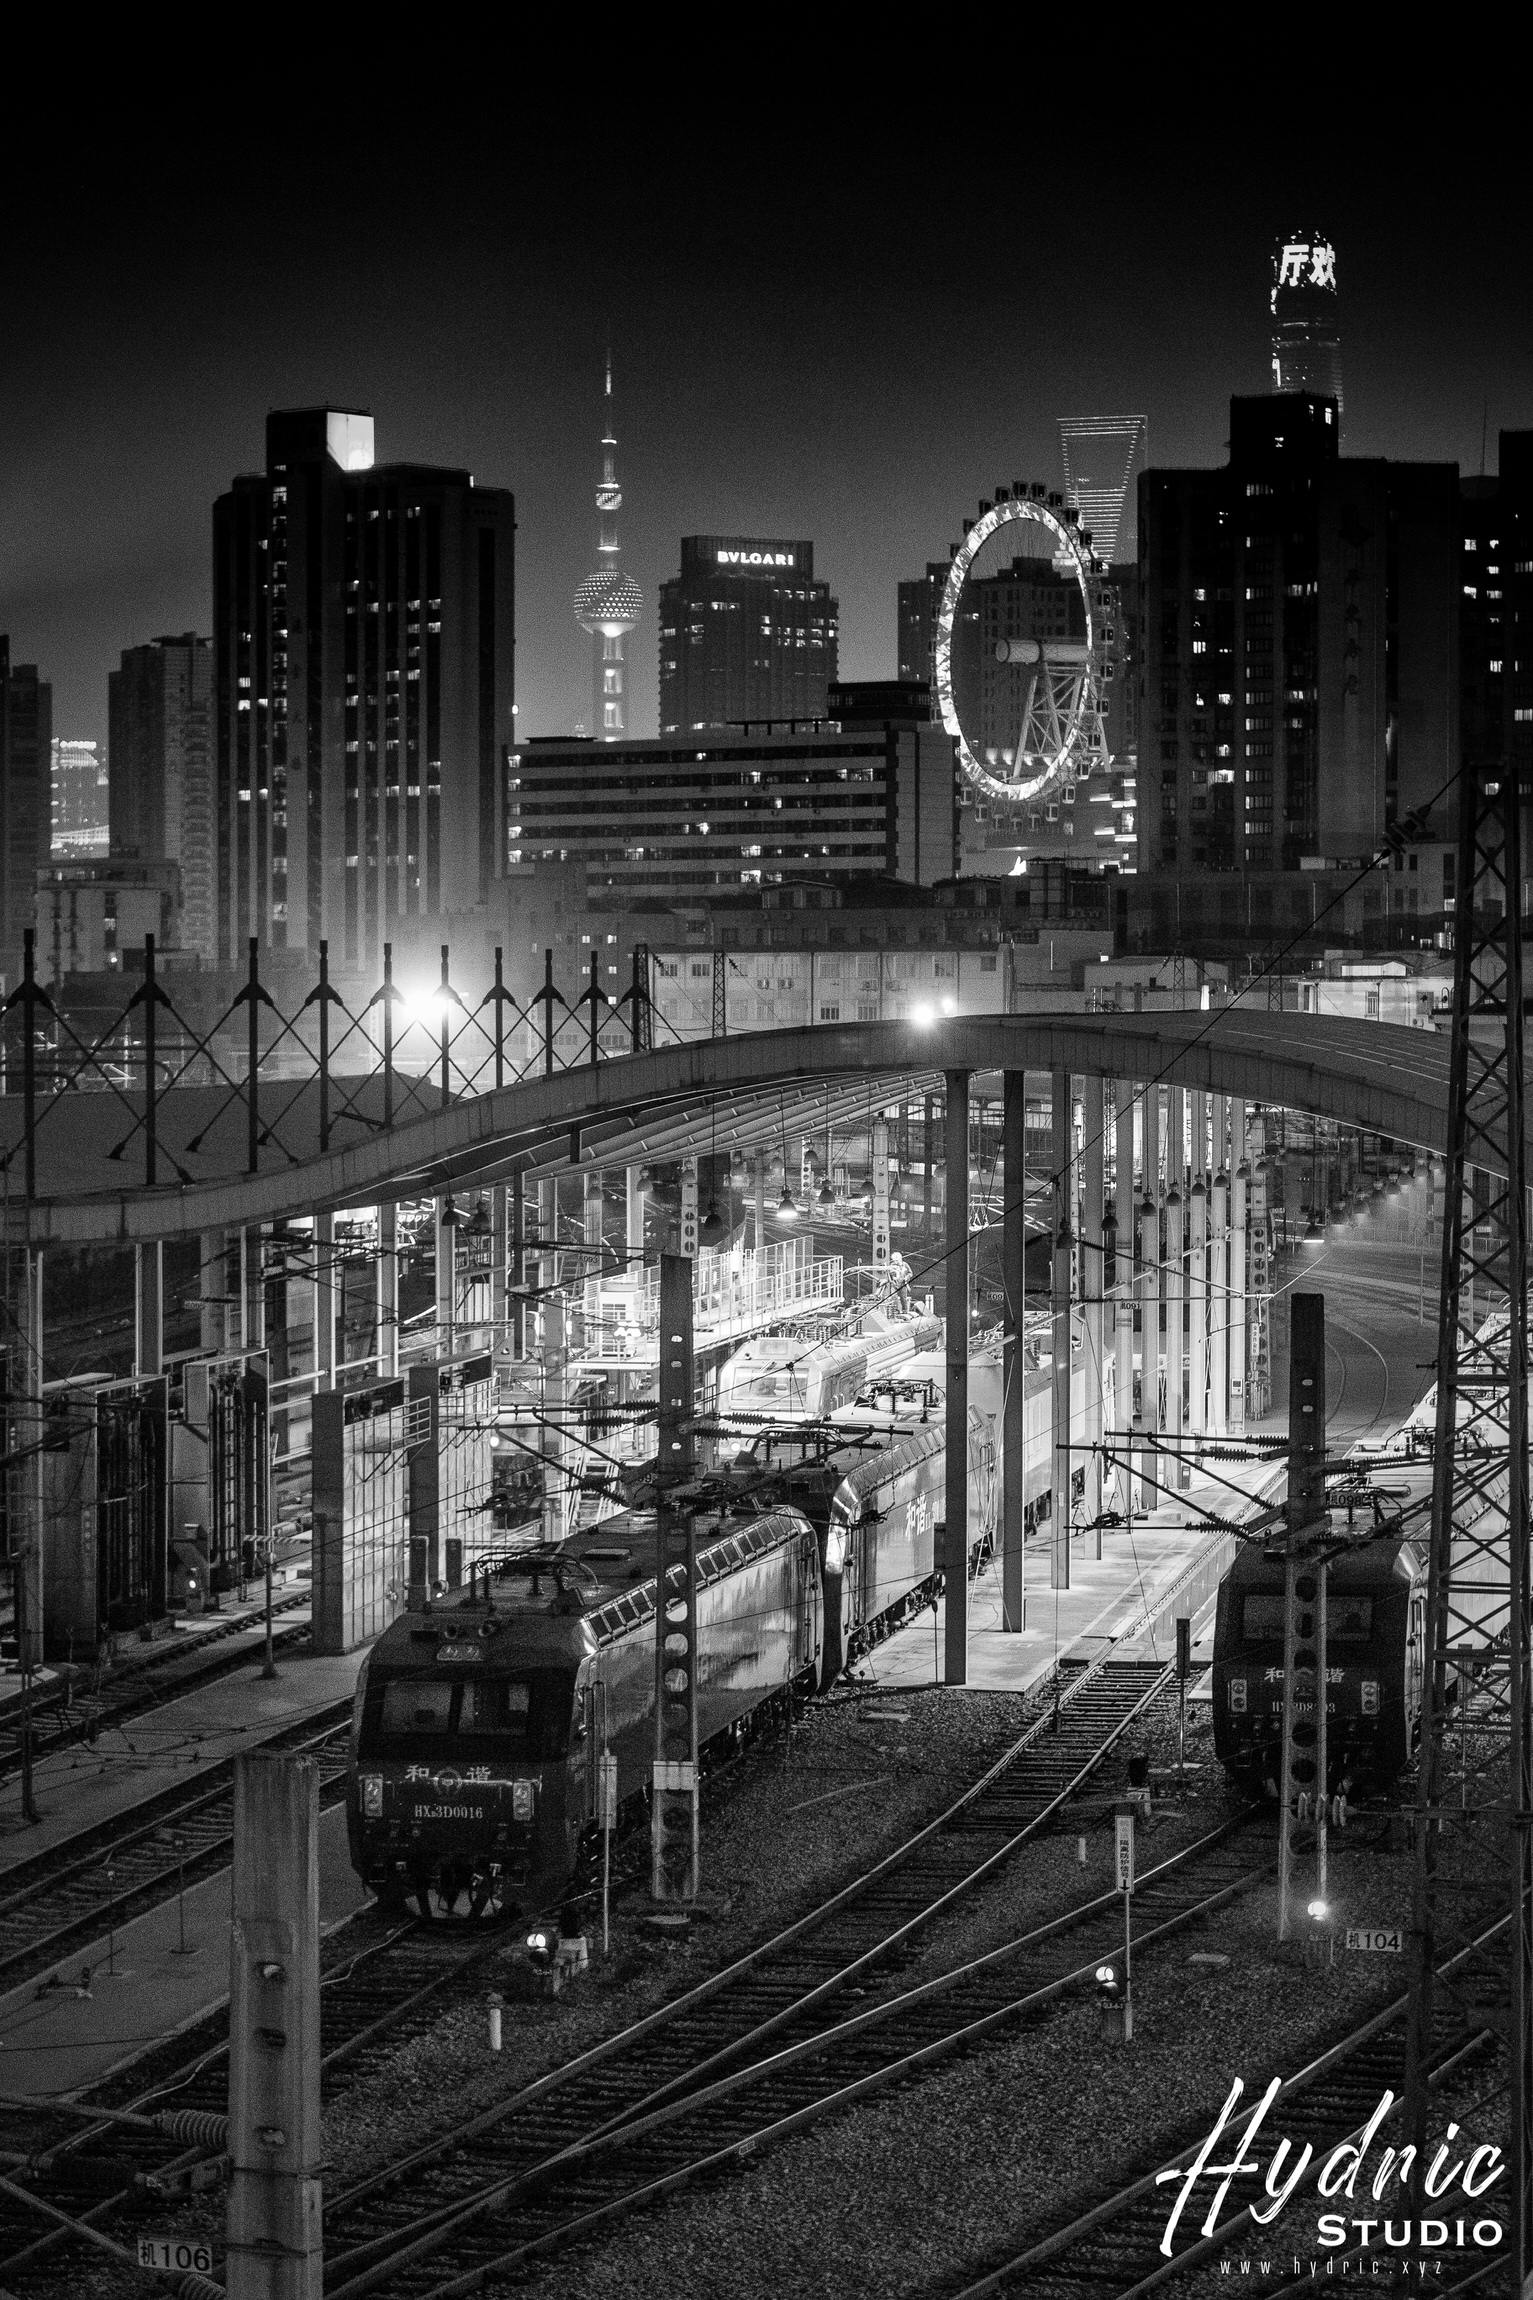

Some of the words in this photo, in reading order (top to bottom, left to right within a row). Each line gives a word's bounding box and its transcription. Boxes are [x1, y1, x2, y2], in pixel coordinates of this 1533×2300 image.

[717, 550, 794, 566] BVLGARI
[404, 1763, 430, 1783] 和
[465, 1765, 492, 1784] 谐
[1348, 1931, 1400, 1950] 机104
[140, 2241, 210, 2272] 机106
